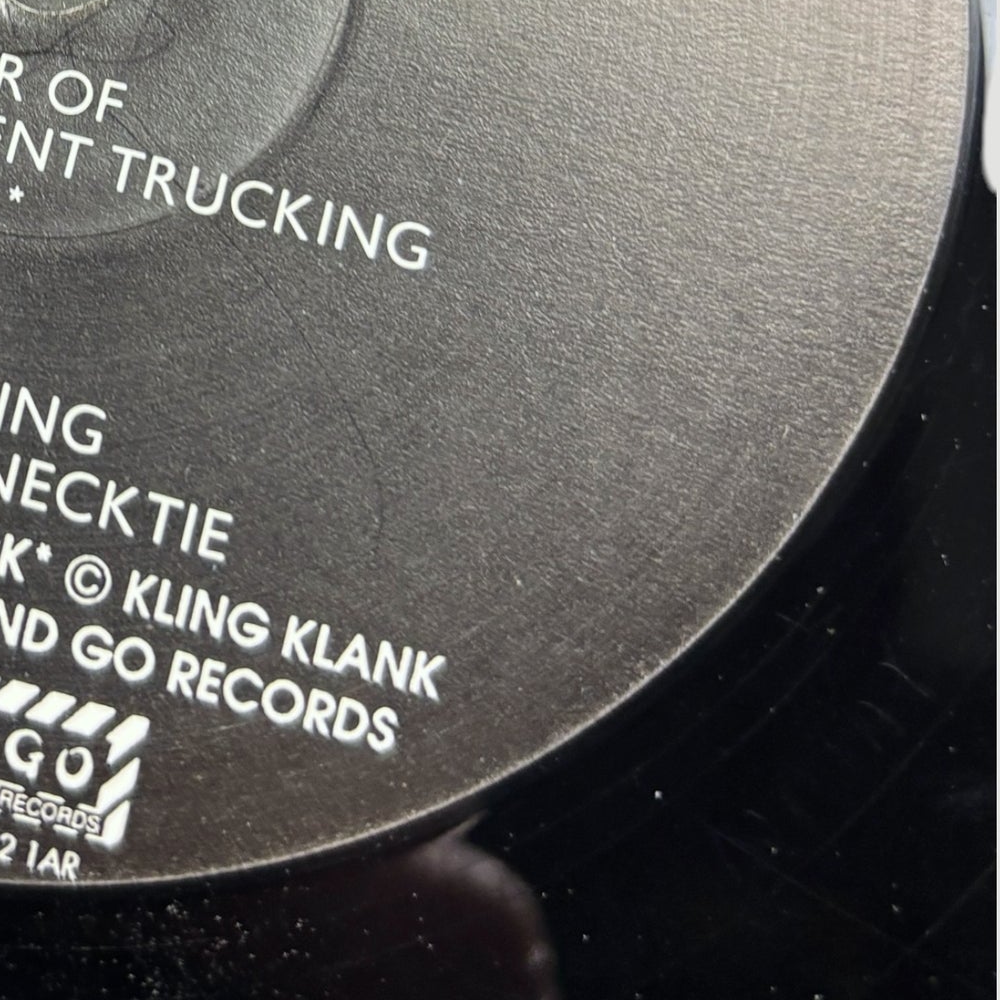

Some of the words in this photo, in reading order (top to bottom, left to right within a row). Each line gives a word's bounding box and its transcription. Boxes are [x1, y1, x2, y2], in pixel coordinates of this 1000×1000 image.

[47, 69, 128, 123] OF
[111, 144, 432, 271] TRUCKING
[71, 625, 156, 682] GO
[166, 649, 399, 753] RECORDS
[122, 569, 270, 649] KLING
[281, 614, 446, 701] KLANK
[4, 728, 94, 790] GO
